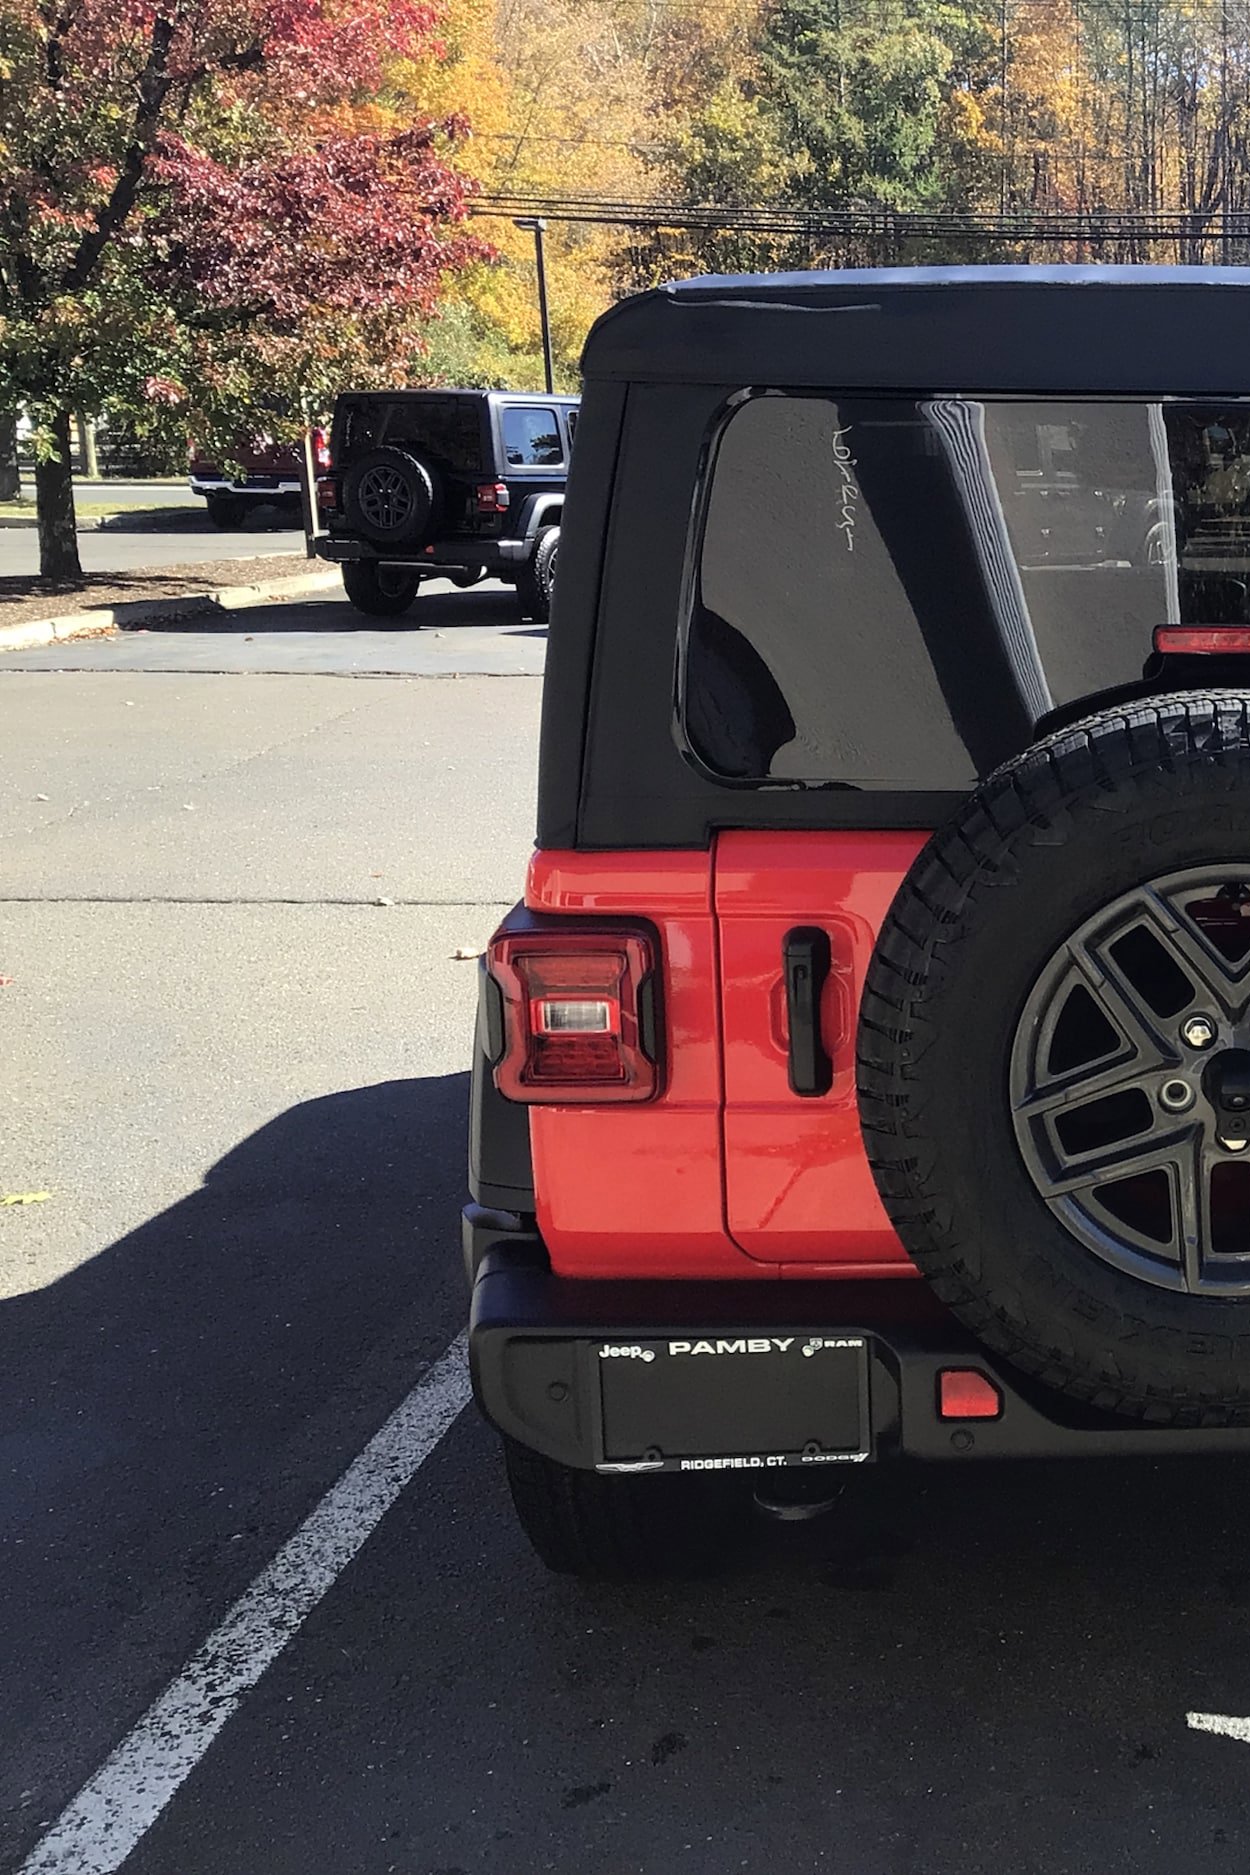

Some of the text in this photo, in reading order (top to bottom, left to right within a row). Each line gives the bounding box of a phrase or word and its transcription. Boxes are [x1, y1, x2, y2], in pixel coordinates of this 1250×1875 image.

[669, 1337, 795, 1356] PAMBY
[823, 1339, 863, 1348] RAM
[599, 1344, 643, 1359] Jeep
[680, 1456, 788, 1471] RIDGEFIELD, CT.
